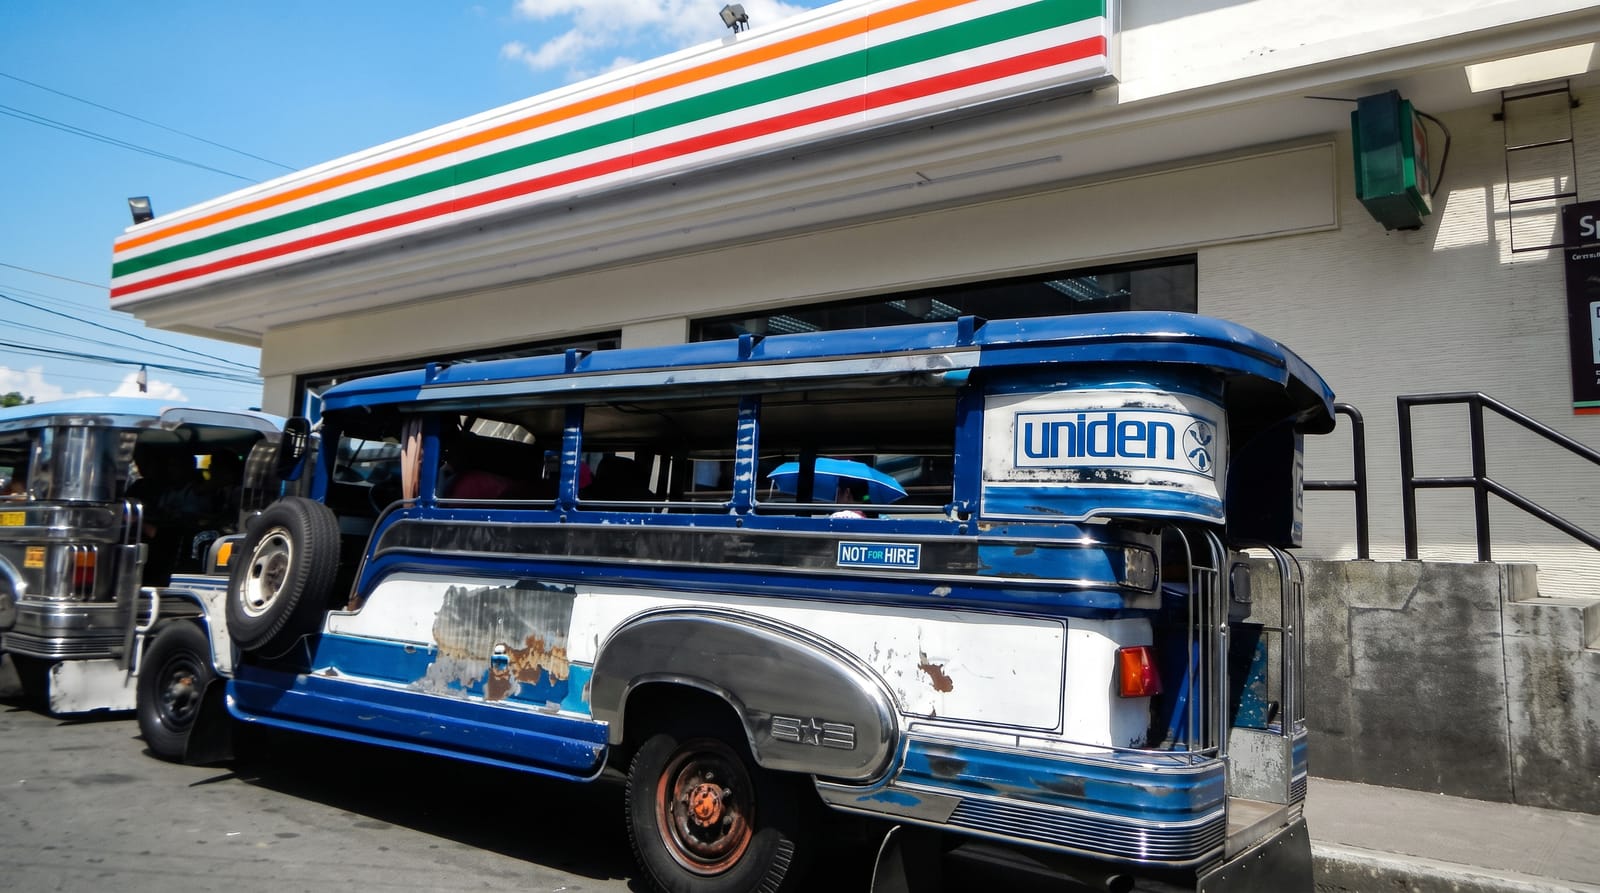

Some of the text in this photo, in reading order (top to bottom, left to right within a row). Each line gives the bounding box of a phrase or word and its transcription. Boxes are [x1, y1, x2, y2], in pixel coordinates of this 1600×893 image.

[1025, 413, 1175, 460] uniden
[842, 546, 915, 564] NOT FOR HIRE
